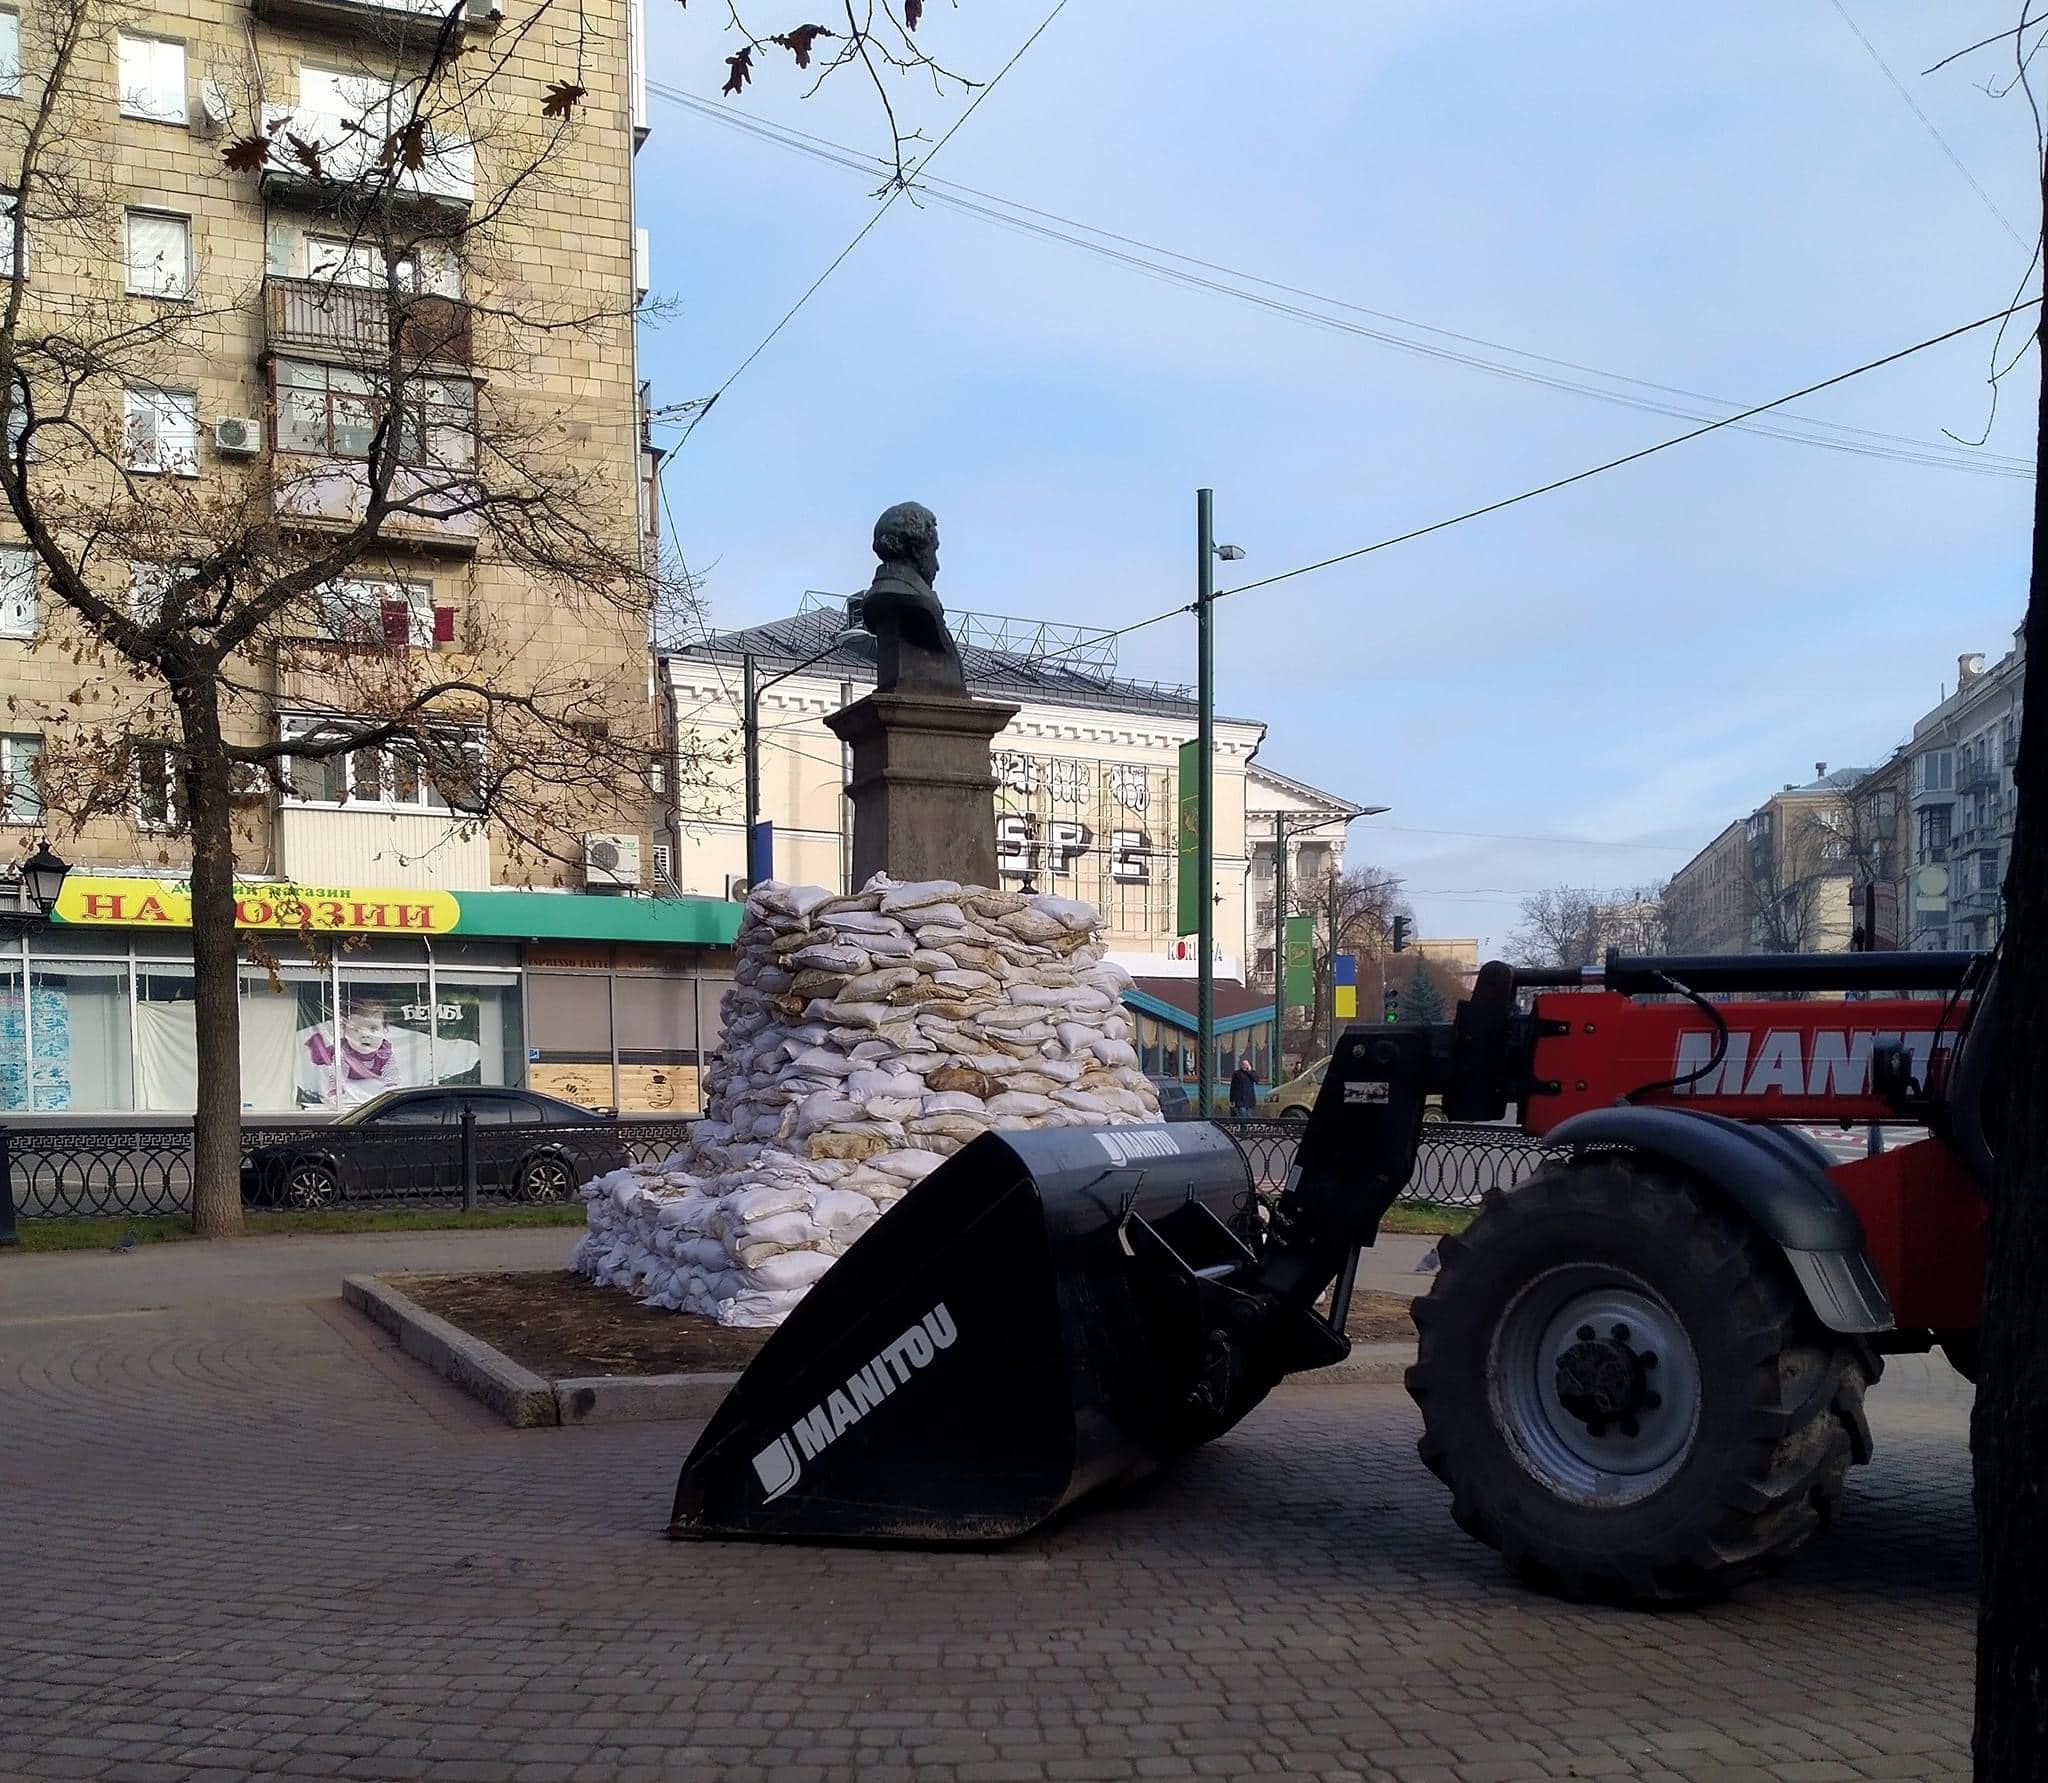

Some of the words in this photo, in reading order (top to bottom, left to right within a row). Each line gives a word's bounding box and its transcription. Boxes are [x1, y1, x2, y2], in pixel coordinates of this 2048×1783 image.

[82, 894, 169, 921] НА
[1110, 1130, 1180, 1159] MANITOU
[792, 1302, 958, 1461] MANITOU
